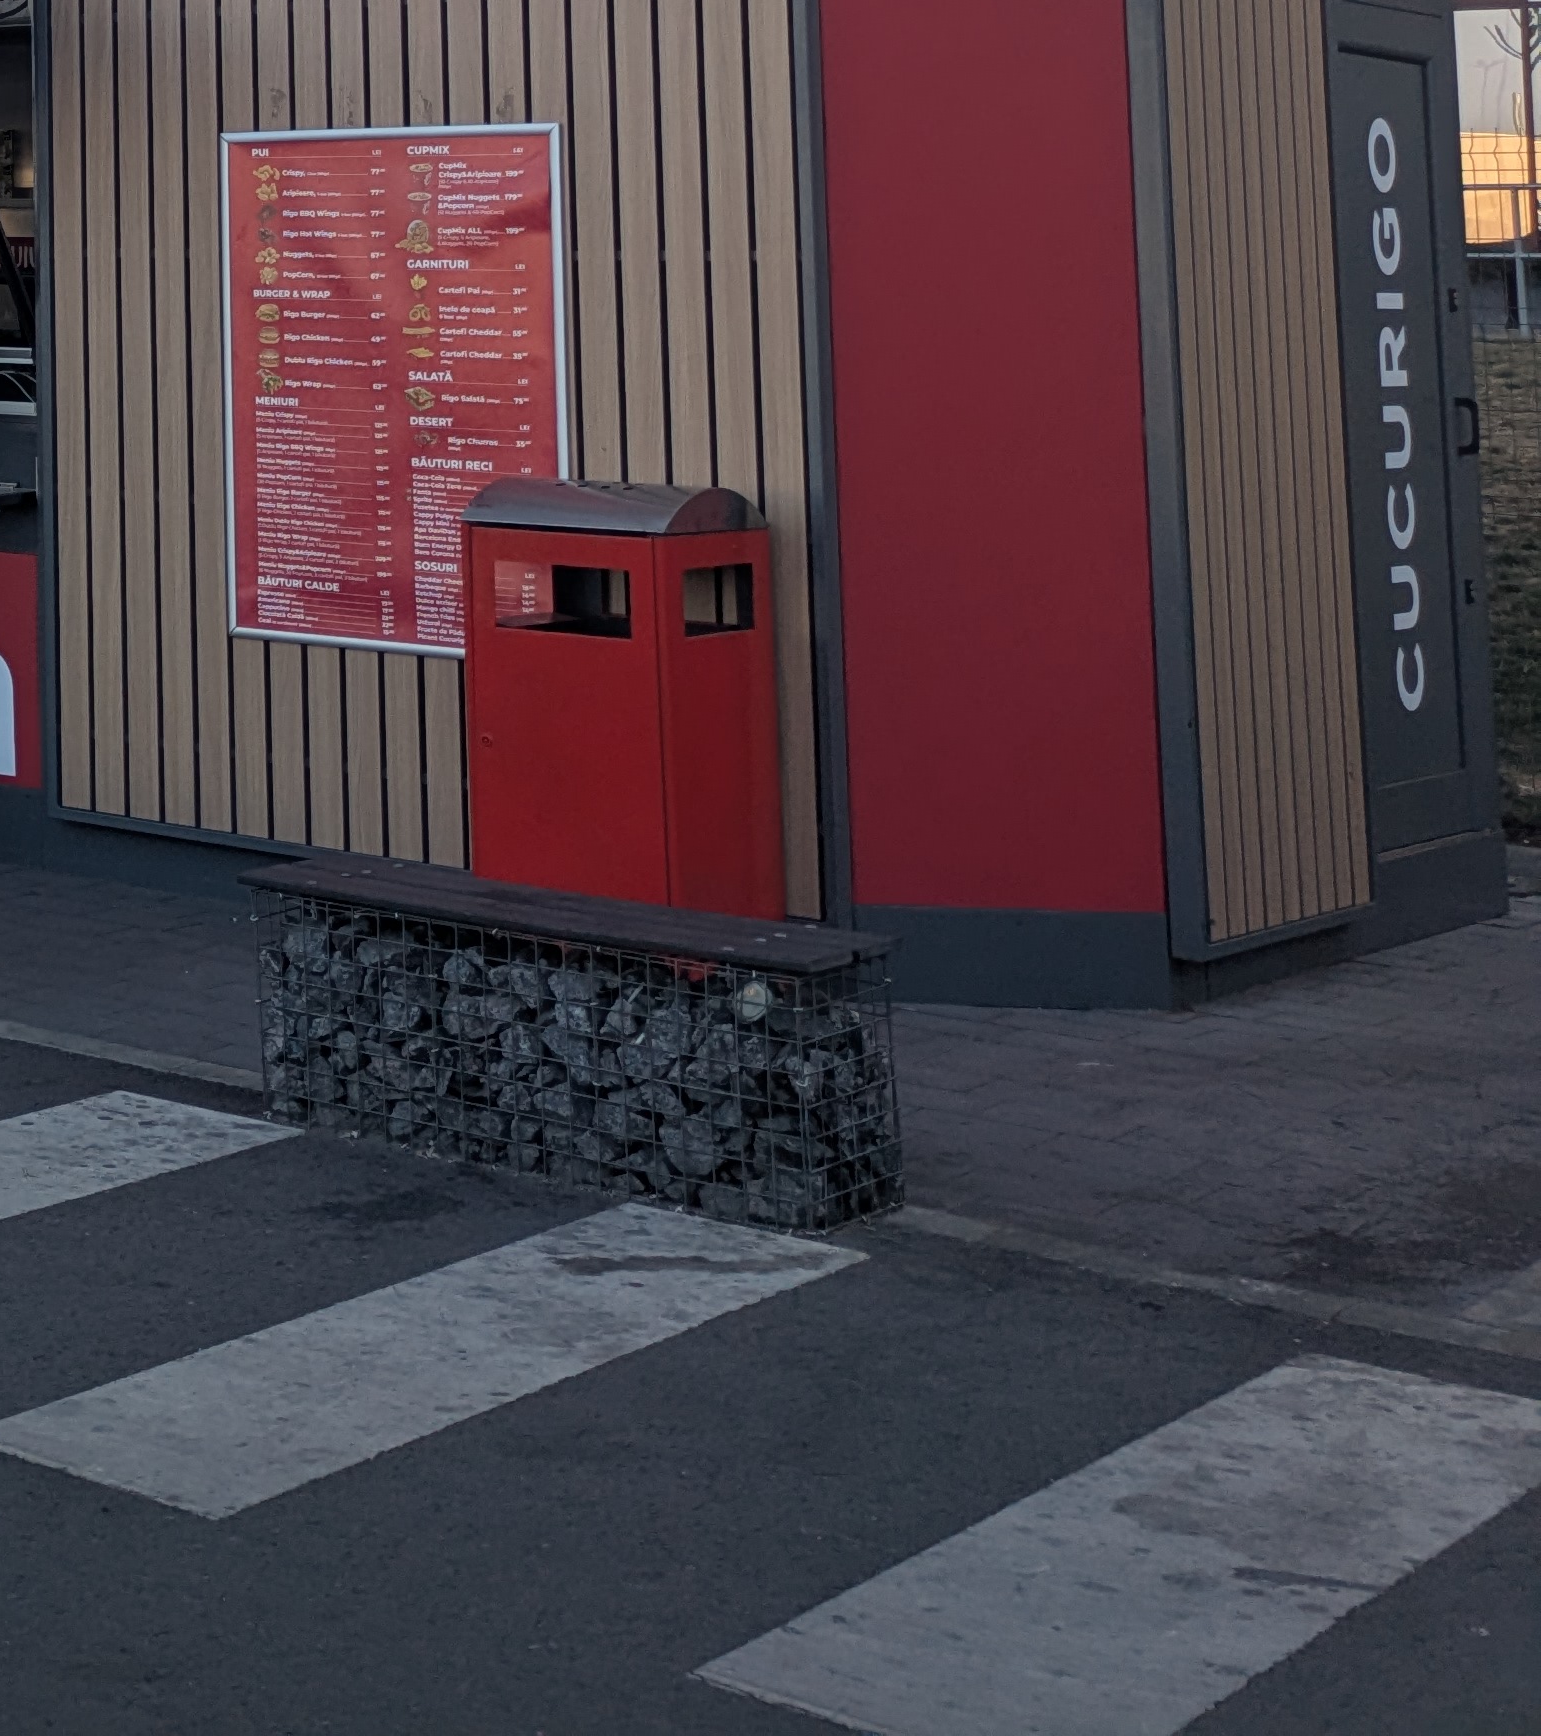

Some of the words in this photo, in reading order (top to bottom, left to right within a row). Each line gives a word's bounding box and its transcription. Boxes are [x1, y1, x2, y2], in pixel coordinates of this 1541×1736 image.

[252, 148, 269, 157] PUI
[407, 146, 449, 154] CUPMIX
[407, 259, 469, 269] GARNITURI
[253, 290, 290, 298] BURGER
[292, 290, 299, 298] &
[301, 290, 330, 298] WRAP
[301, 311, 325, 319] Burger
[469, 351, 502, 359] Cheddar
[408, 370, 453, 381] SALATĂ
[255, 396, 298, 406] MENIURI
[1367, 116, 1427, 713] CUCURIGO
[410, 416, 453, 426] DESERT
[411, 456, 462, 469] BĂUTURI
[466, 461, 493, 471] RECI
[415, 561, 457, 573] SOSURI
[258, 575, 303, 589] BĂUTURI
[305, 581, 340, 592] CALDE
